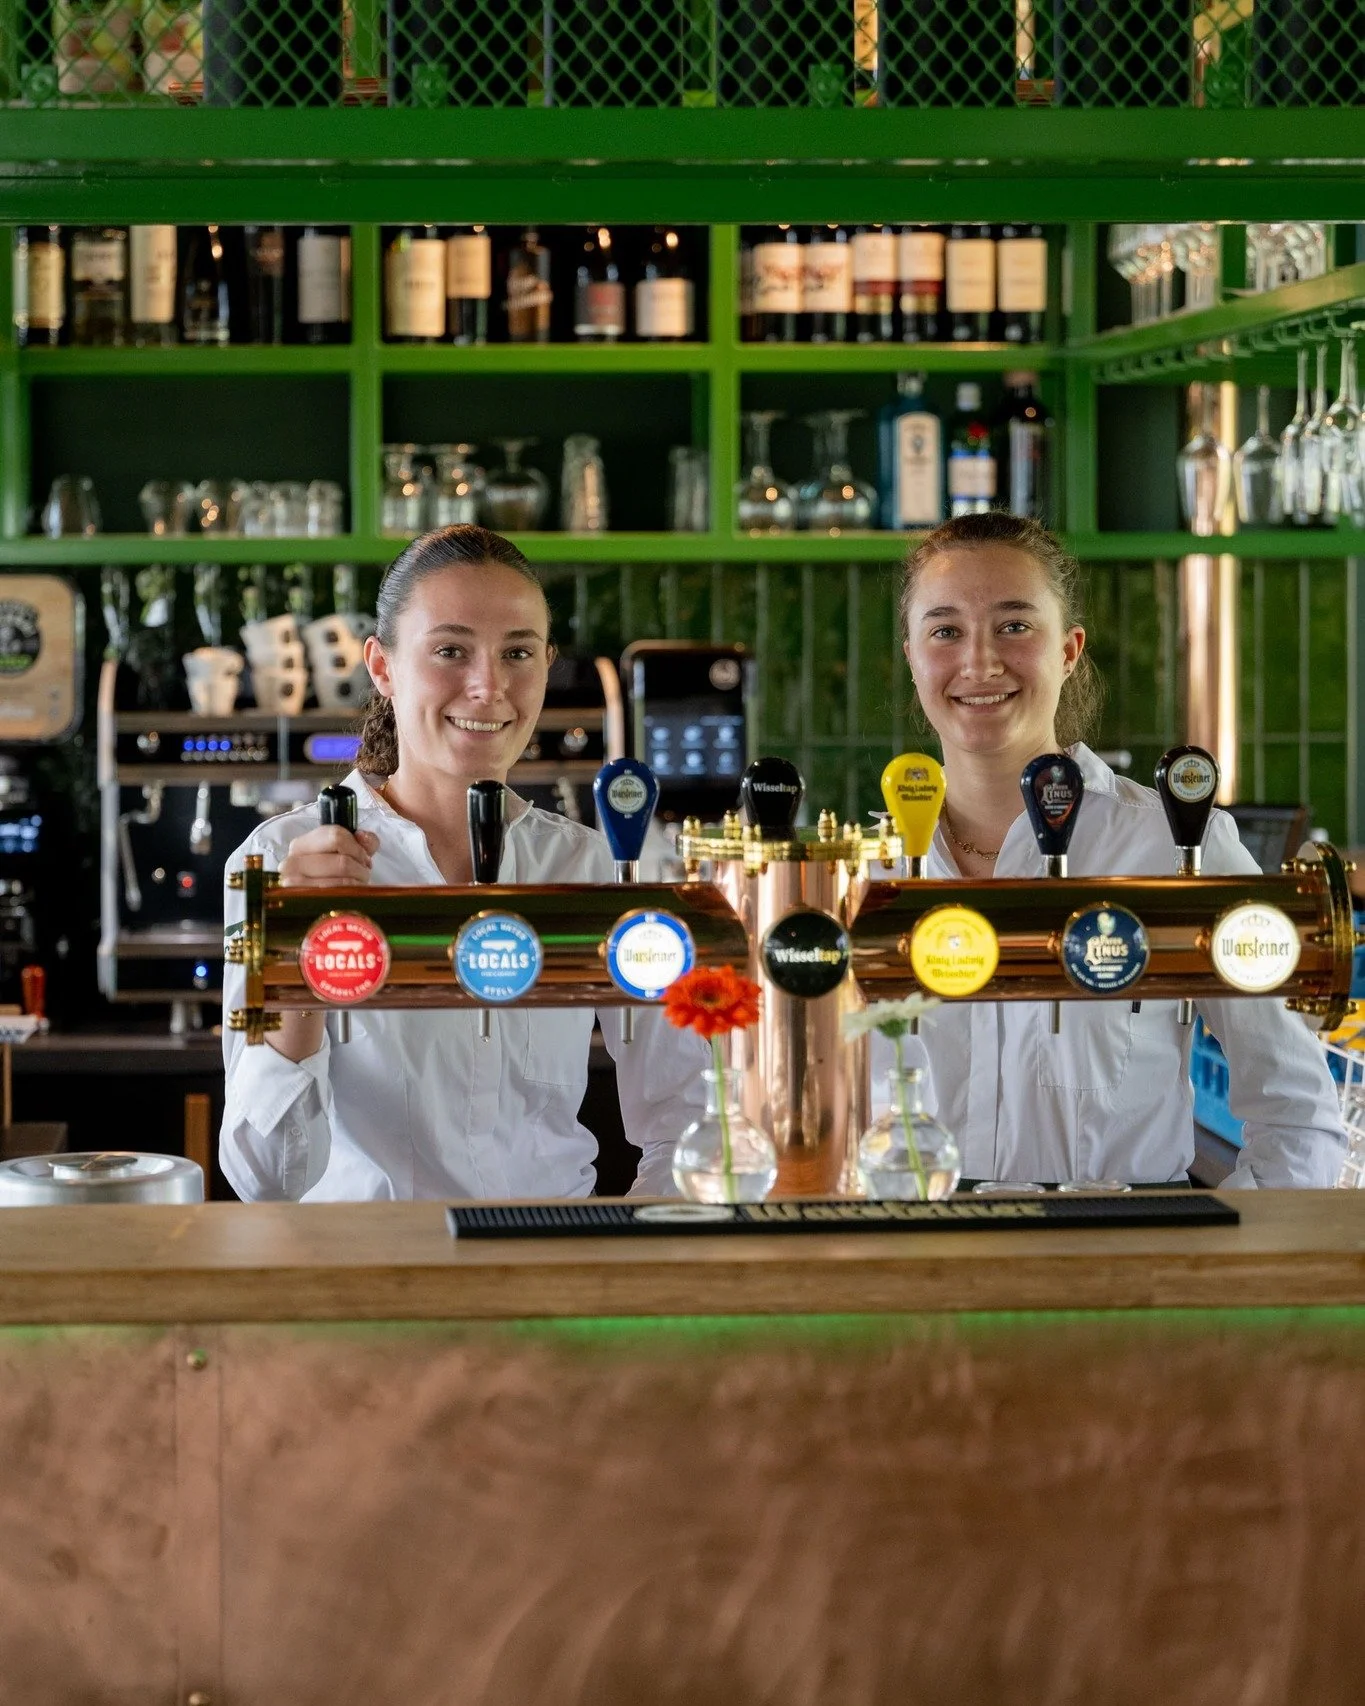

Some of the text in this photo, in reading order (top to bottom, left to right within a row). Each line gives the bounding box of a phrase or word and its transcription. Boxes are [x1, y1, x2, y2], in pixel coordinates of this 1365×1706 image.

[1173, 771, 1211, 785] Warsteiner
[752, 782, 798, 795] Wisseltap
[623, 947, 677, 964] Warsteiner
[774, 946, 841, 965] Wisseltap
[1221, 936, 1290, 959] Warsteiner
[315, 952, 377, 971] LOCALS
[469, 952, 529, 970] LOCALS
